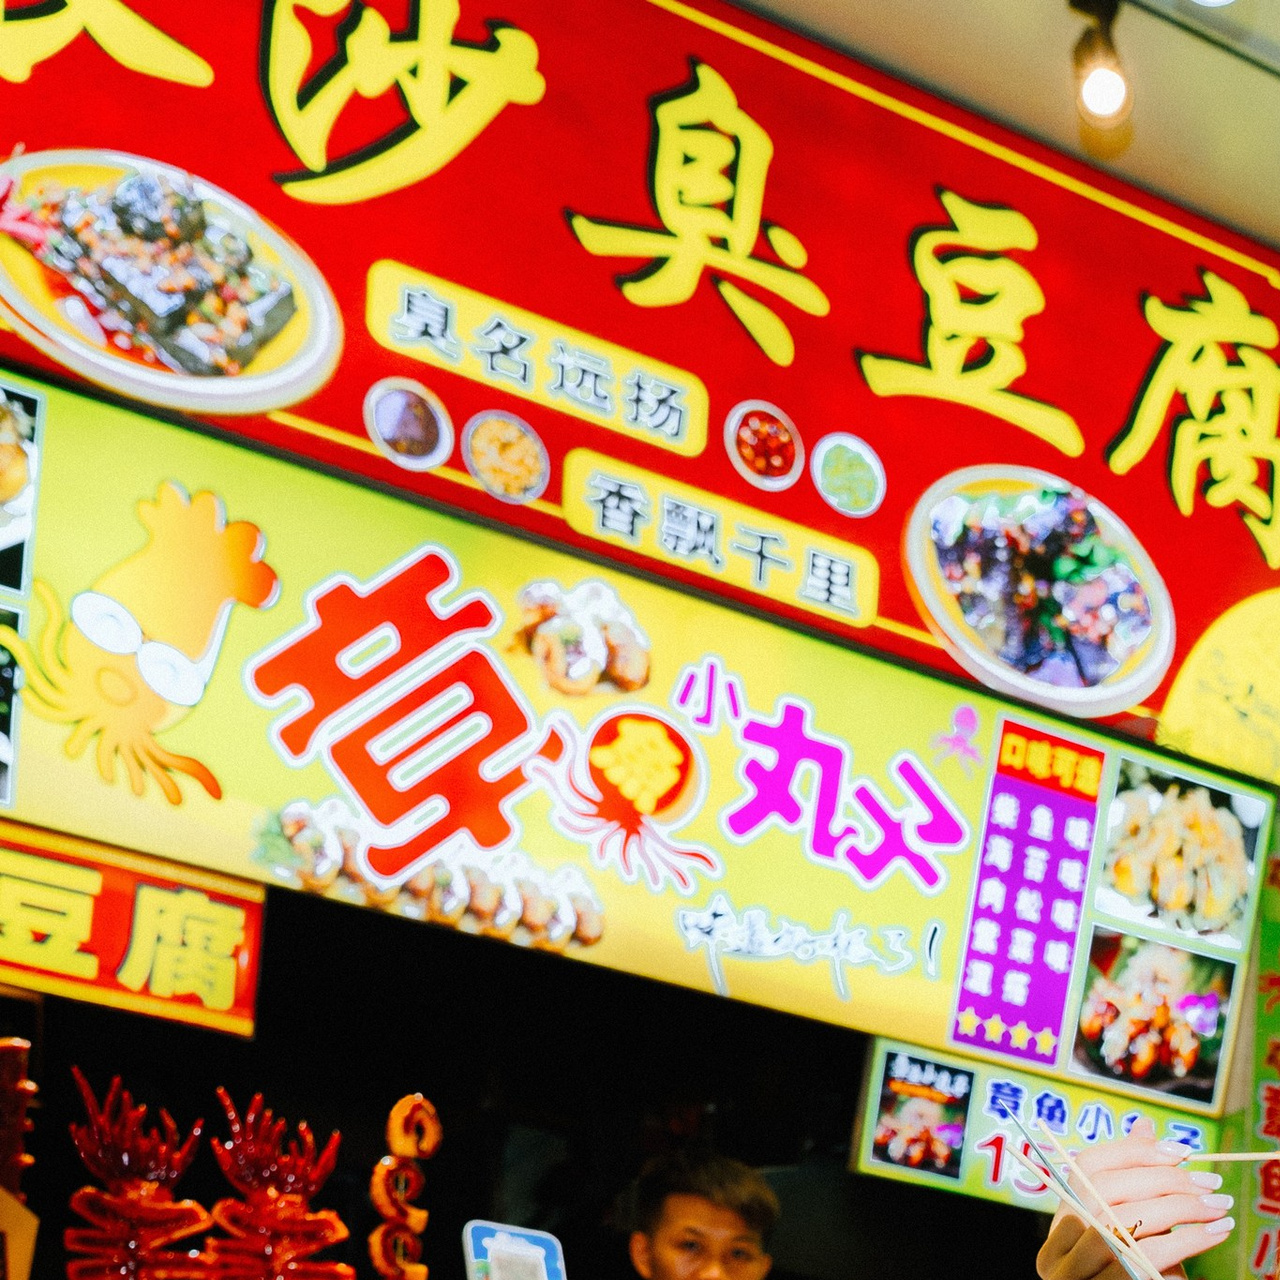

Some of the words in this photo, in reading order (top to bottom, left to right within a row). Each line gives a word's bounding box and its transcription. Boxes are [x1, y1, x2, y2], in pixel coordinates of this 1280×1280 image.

[586, 474, 858, 616] 香飘千里
[977, 1134, 1077, 1195] 15
